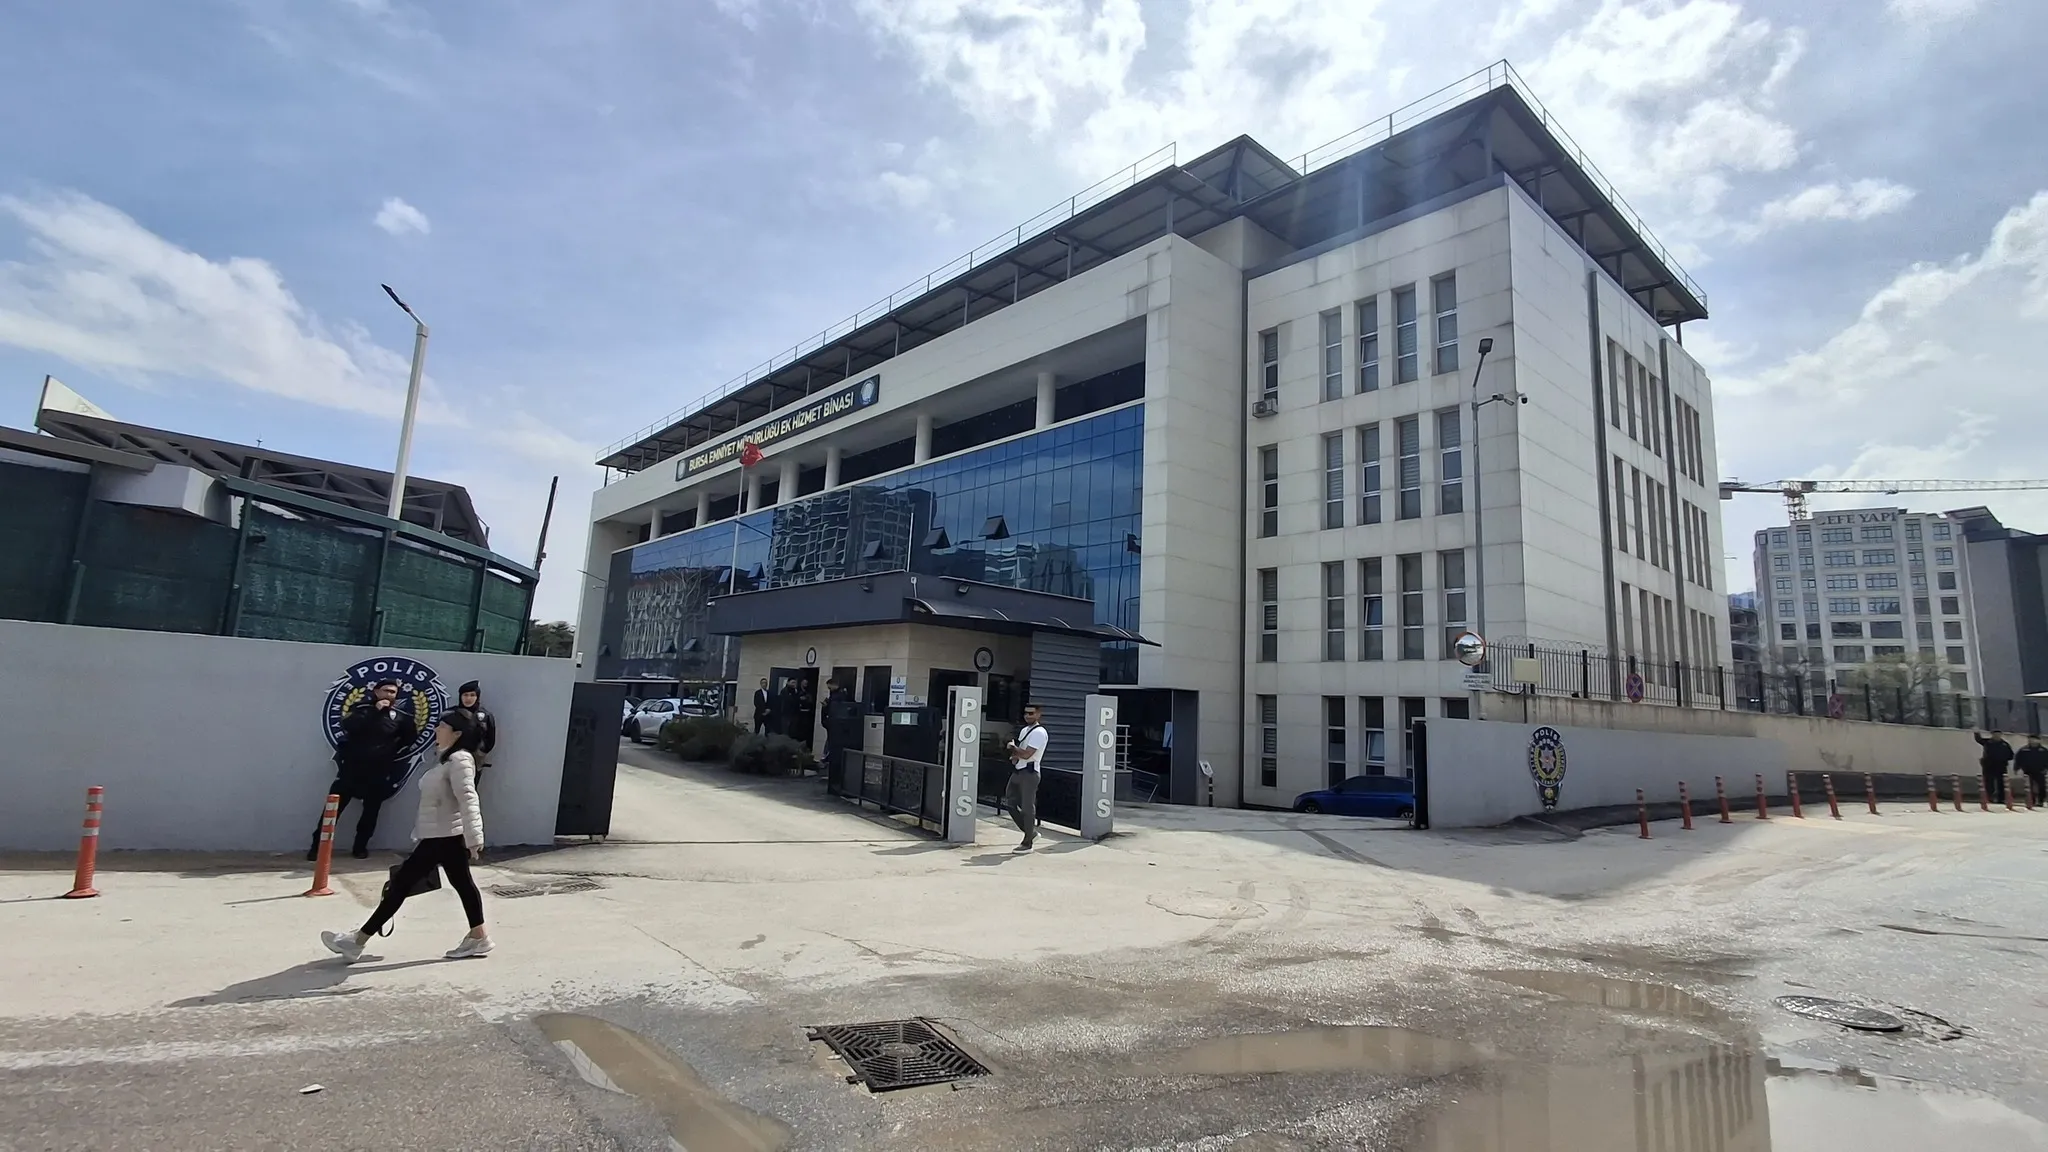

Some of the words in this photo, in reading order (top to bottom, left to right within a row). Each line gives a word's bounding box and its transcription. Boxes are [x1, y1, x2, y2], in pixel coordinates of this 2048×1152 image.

[689, 453, 708, 471] BURSA
[709, 442, 736, 463] EMNİYET
[780, 418, 792, 434] EK
[792, 405, 822, 429] HİZMET
[823, 391, 854, 417] BİNASI
[1859, 512, 1897, 523] YAPI
[356, 661, 428, 681] POLİS
[955, 697, 978, 817] POLİS
[1096, 707, 1115, 819] POLİS
